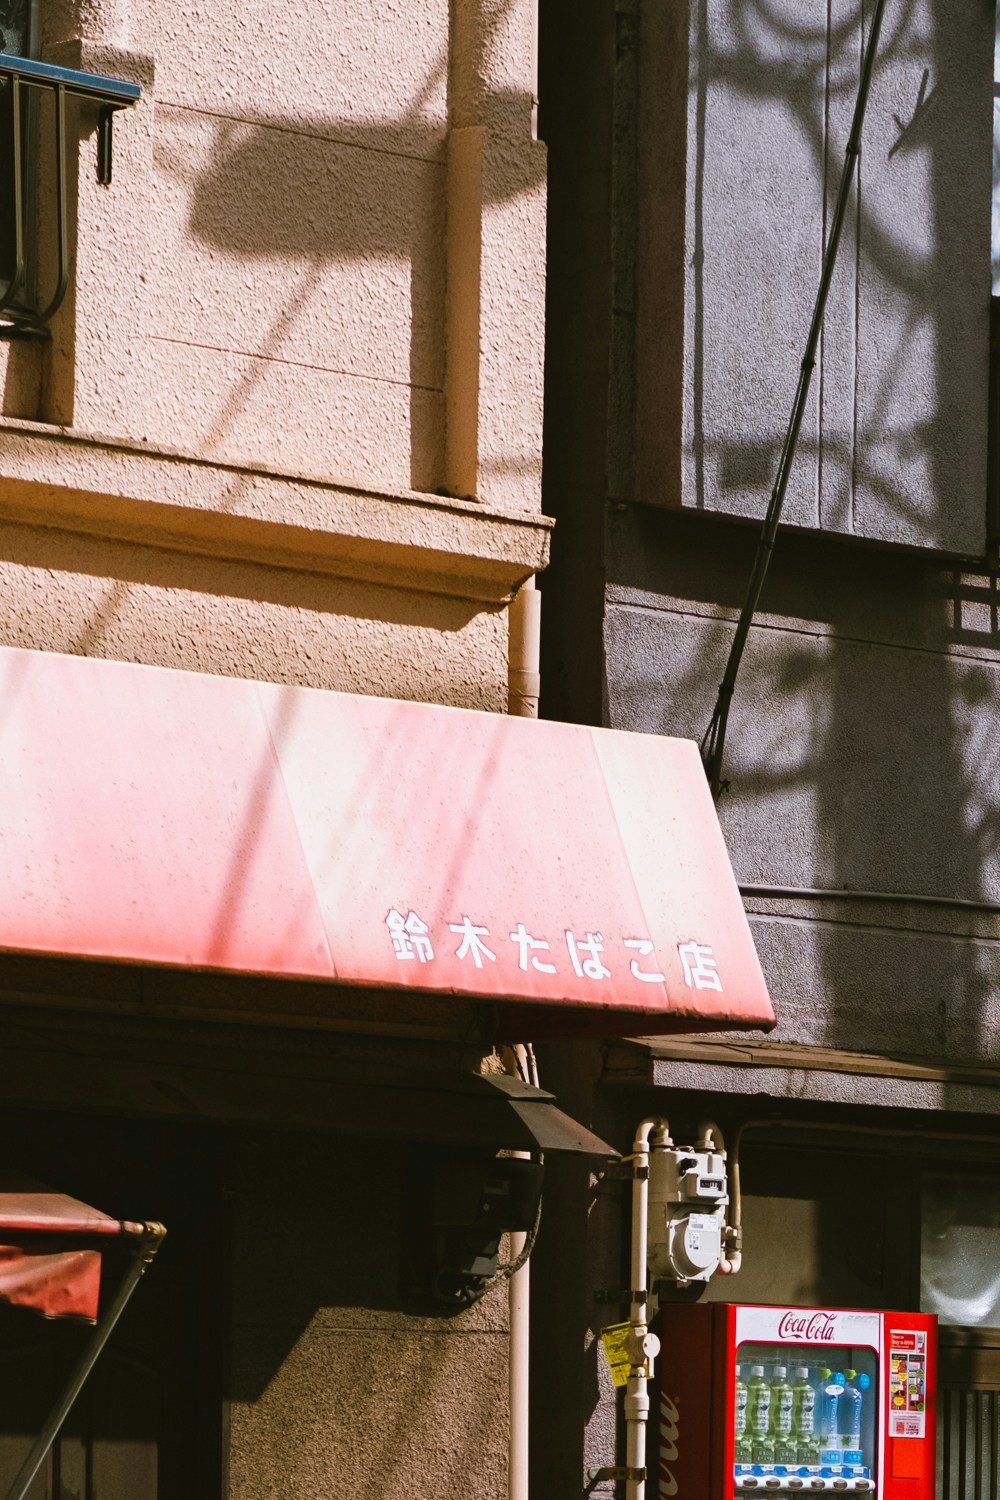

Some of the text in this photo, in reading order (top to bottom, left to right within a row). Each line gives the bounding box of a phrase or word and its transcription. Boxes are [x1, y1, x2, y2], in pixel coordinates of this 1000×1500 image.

[385, 908, 724, 993] 鈴木たばこ店
[778, 1311, 838, 1341] Coca-Cola
